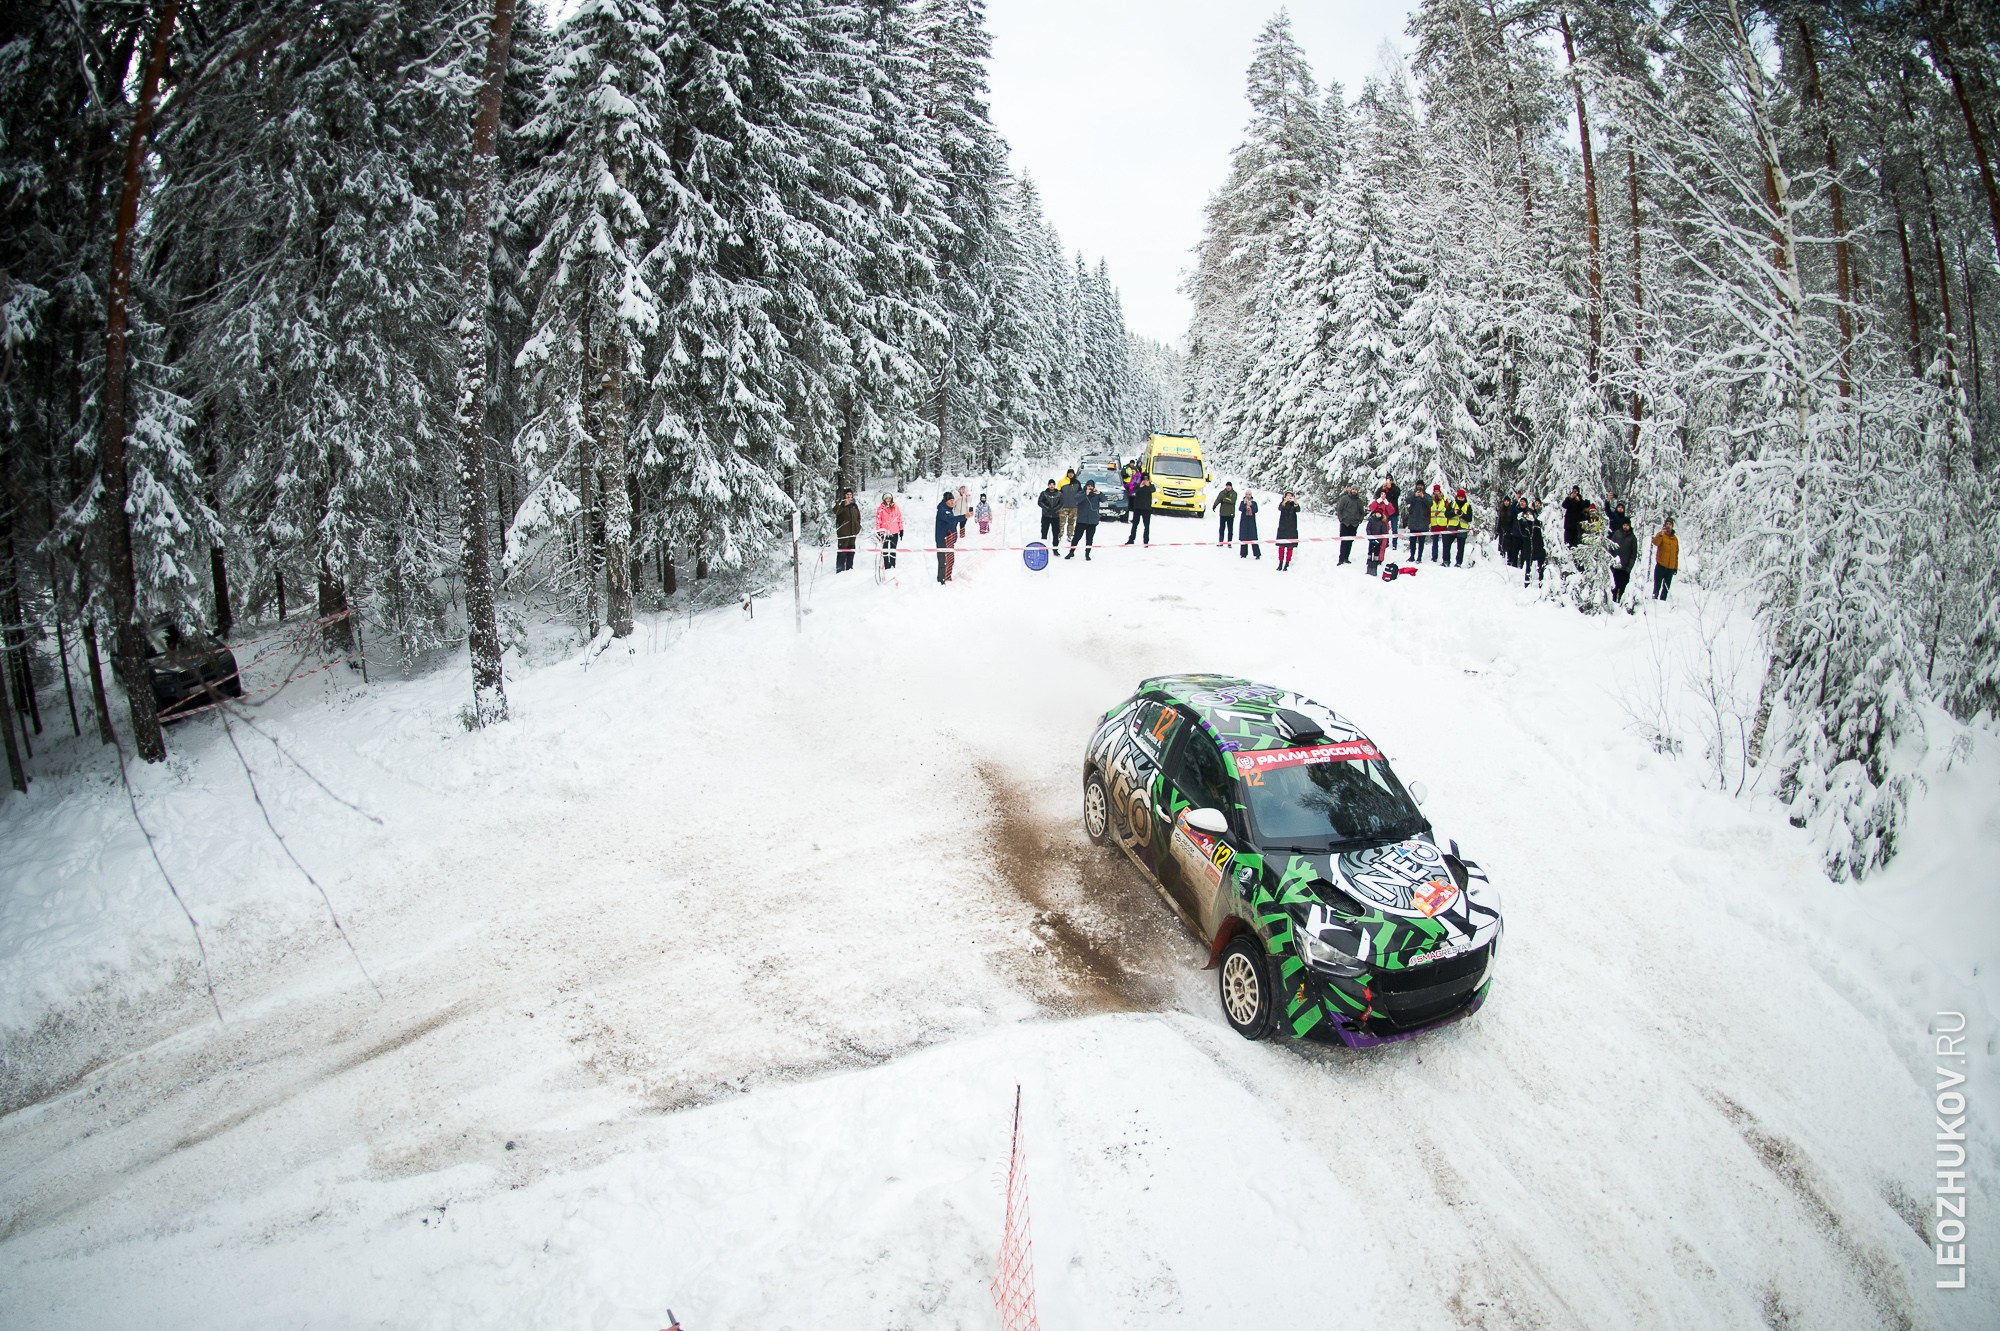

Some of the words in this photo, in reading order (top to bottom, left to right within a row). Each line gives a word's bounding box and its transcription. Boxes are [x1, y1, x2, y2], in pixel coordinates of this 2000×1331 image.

[1152, 705, 1177, 742] 12
[1256, 749, 1309, 766] РАЛЛИ
[1310, 746, 1363, 757] РОССИИ
[1240, 769, 1265, 787] 12
[1200, 838, 1215, 854] 24
[1213, 844, 1232, 871] 12
[1352, 840, 1441, 902] NEO
